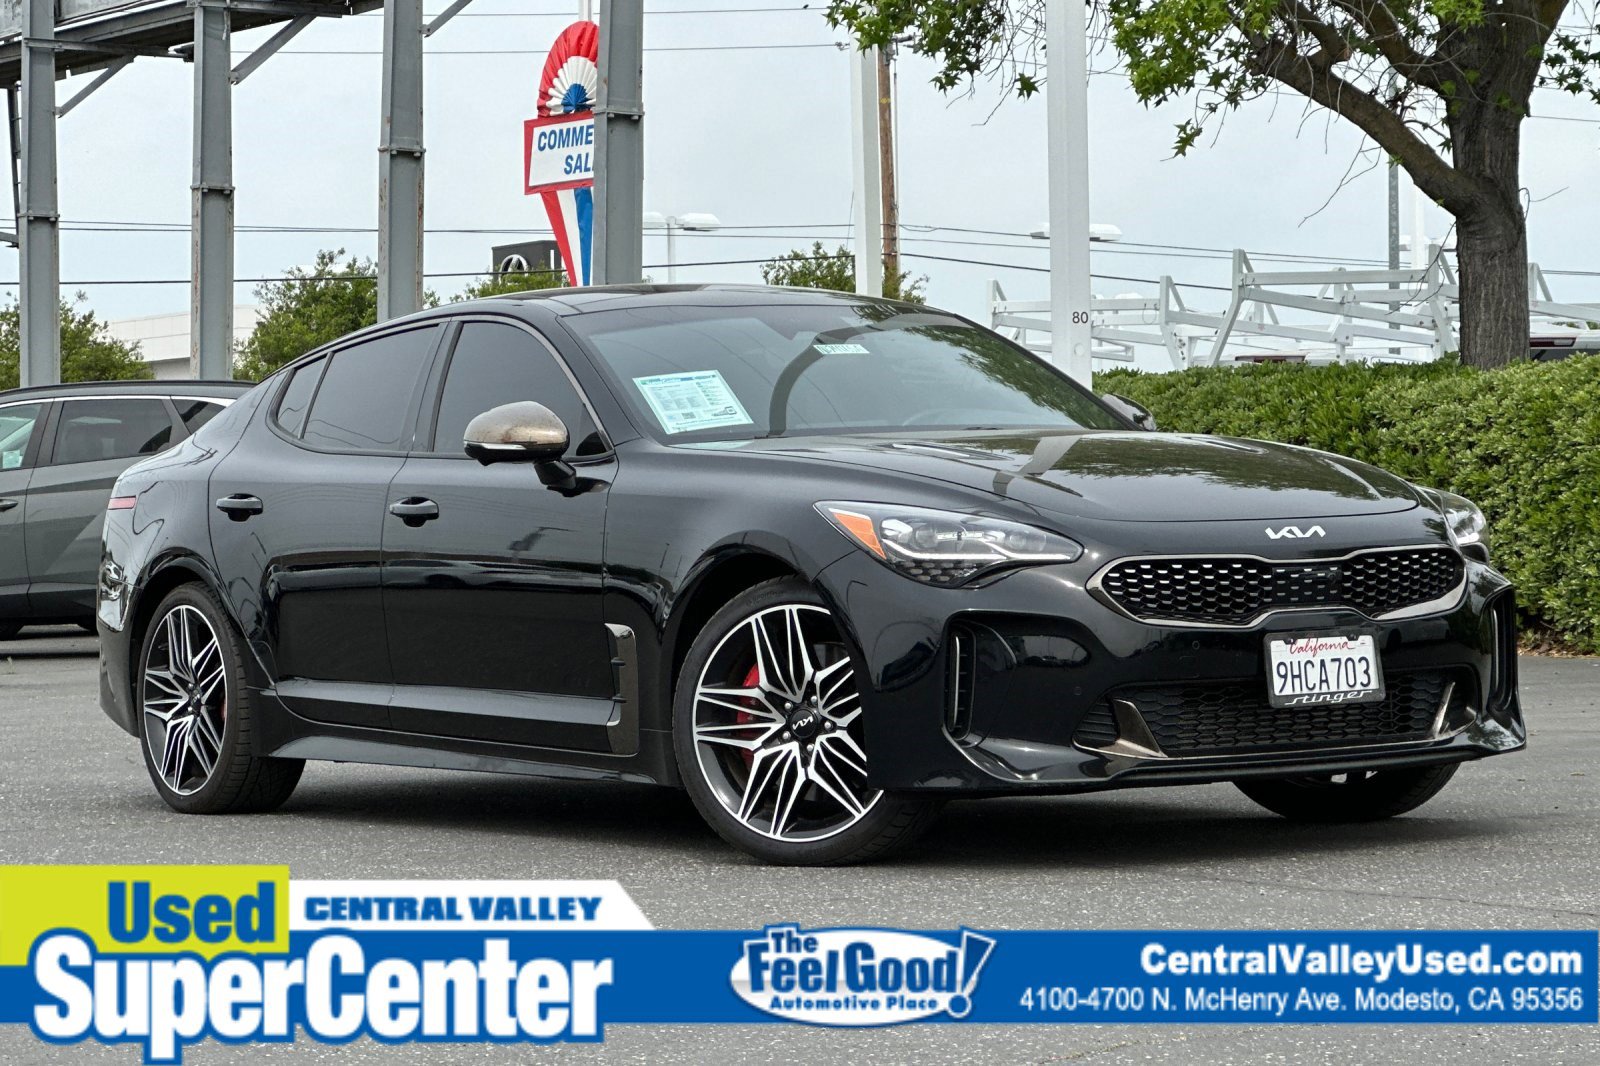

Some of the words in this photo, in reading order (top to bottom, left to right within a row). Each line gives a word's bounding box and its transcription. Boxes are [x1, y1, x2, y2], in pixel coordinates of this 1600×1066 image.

[537, 124, 594, 152] COMME
[563, 152, 594, 175] SAL
[1072, 311, 1089, 324] 80
[1264, 525, 1326, 539] KIA
[1289, 638, 1355, 657] California
[1276, 656, 1371, 693] 9HCA703
